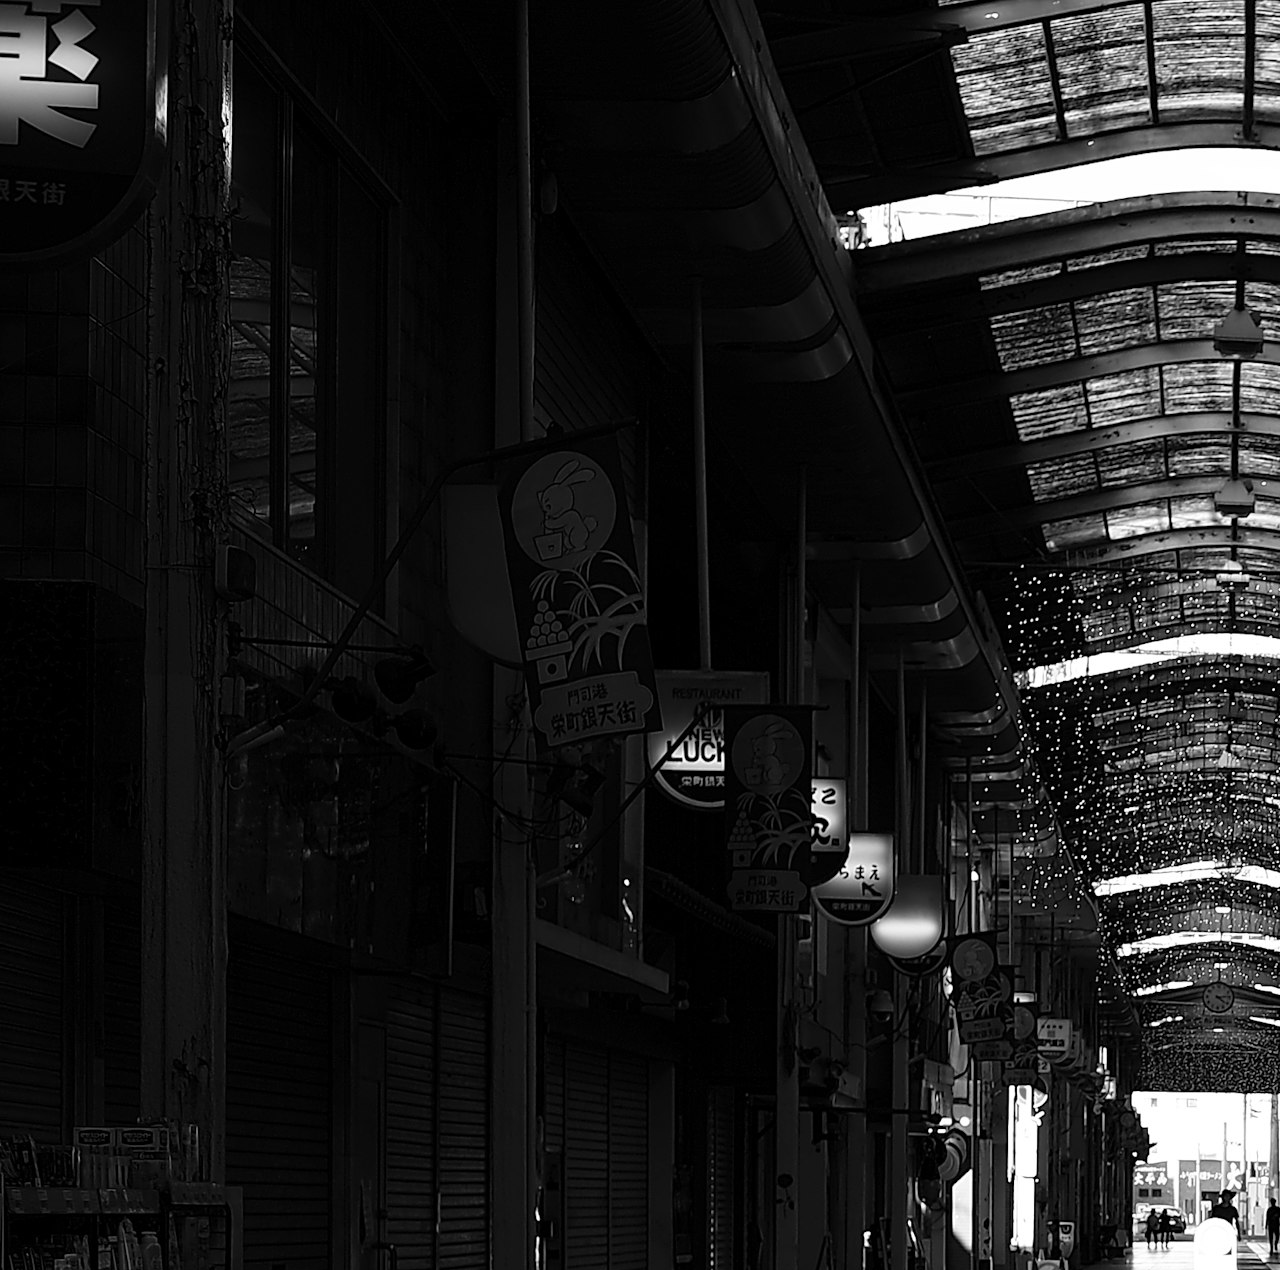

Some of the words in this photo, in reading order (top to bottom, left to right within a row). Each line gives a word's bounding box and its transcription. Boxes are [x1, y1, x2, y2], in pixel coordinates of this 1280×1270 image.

[567, 683, 609, 707] 門司港
[672, 687, 741, 699] RESTAURANT
[551, 701, 636, 738] 栄町銀天街
